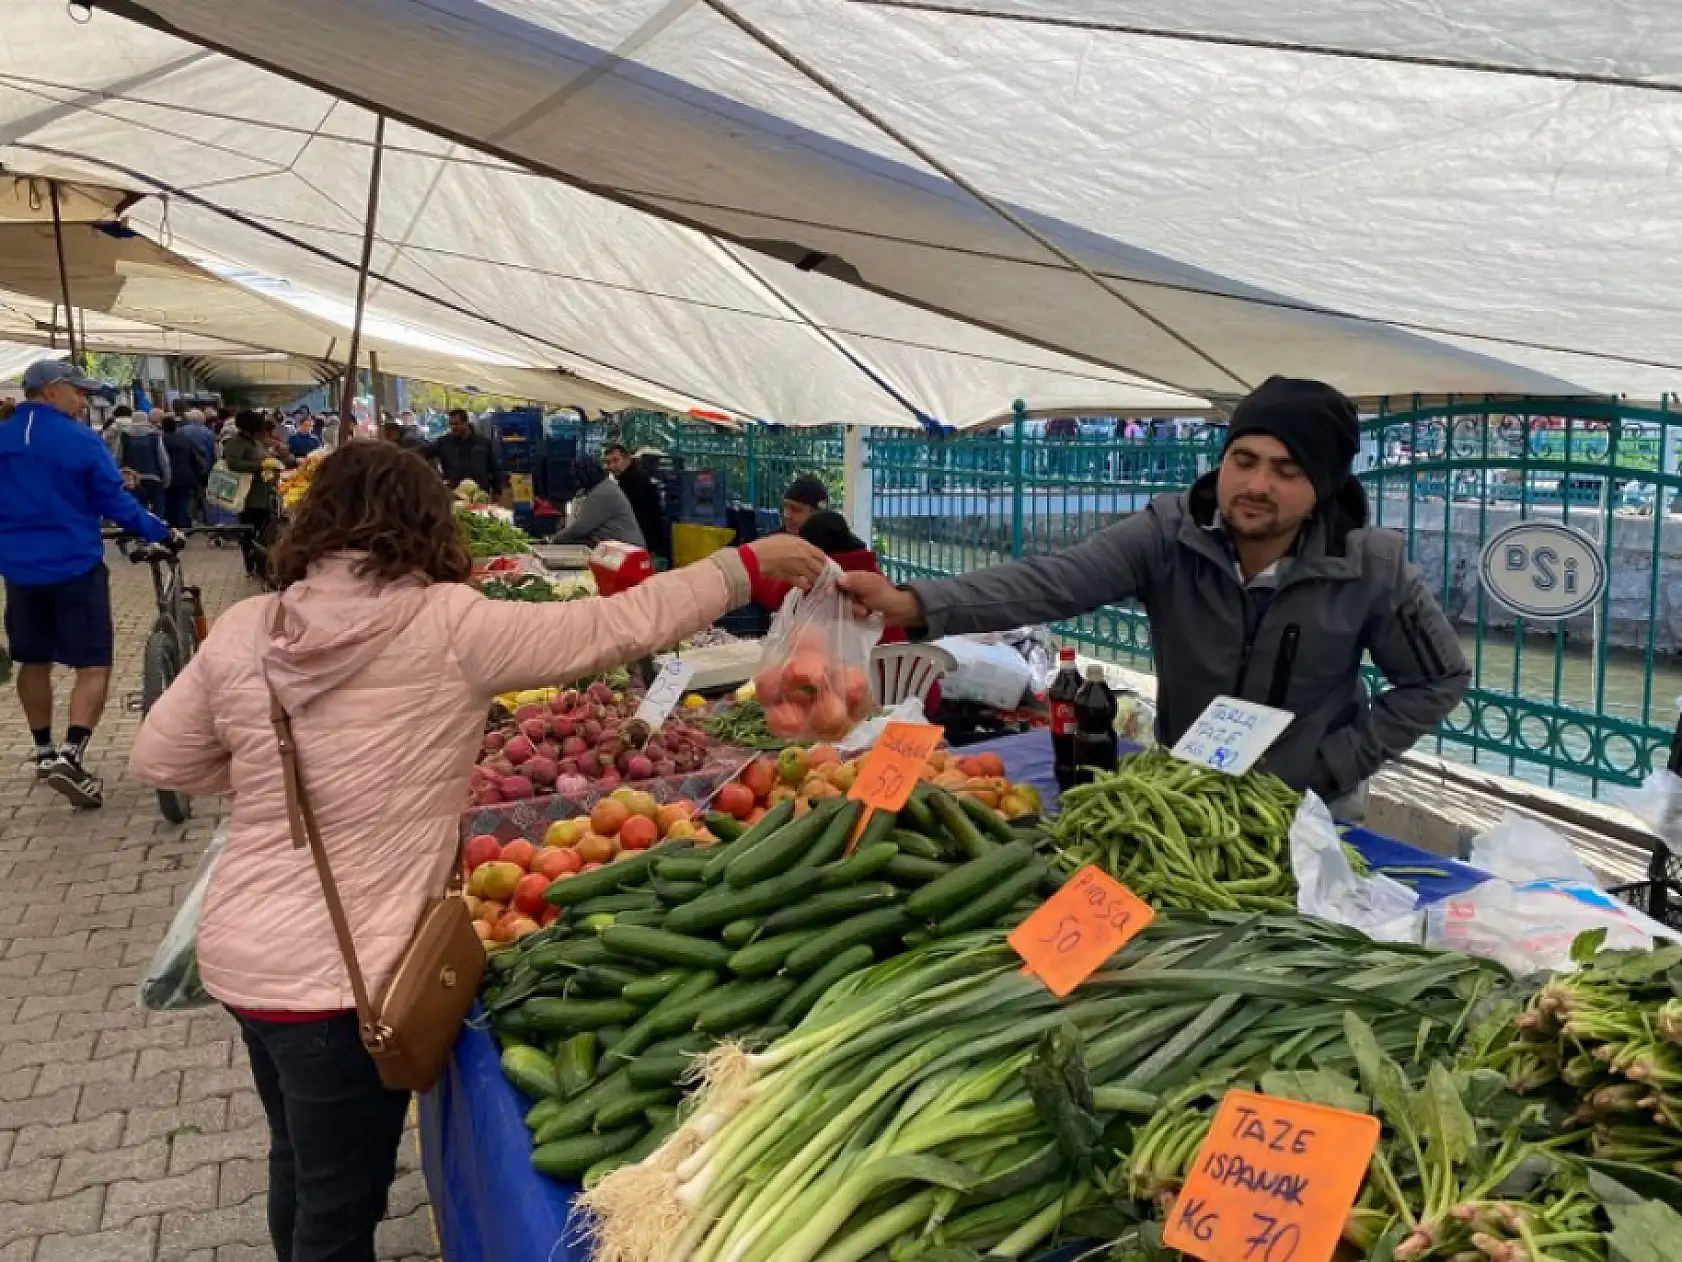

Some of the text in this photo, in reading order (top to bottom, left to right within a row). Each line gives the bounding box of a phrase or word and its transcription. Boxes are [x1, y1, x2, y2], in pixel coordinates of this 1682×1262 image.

[1038, 915, 1082, 953] 50
[1232, 1106, 1315, 1154] TAZE
[1179, 1199, 1301, 1262] KG 70
